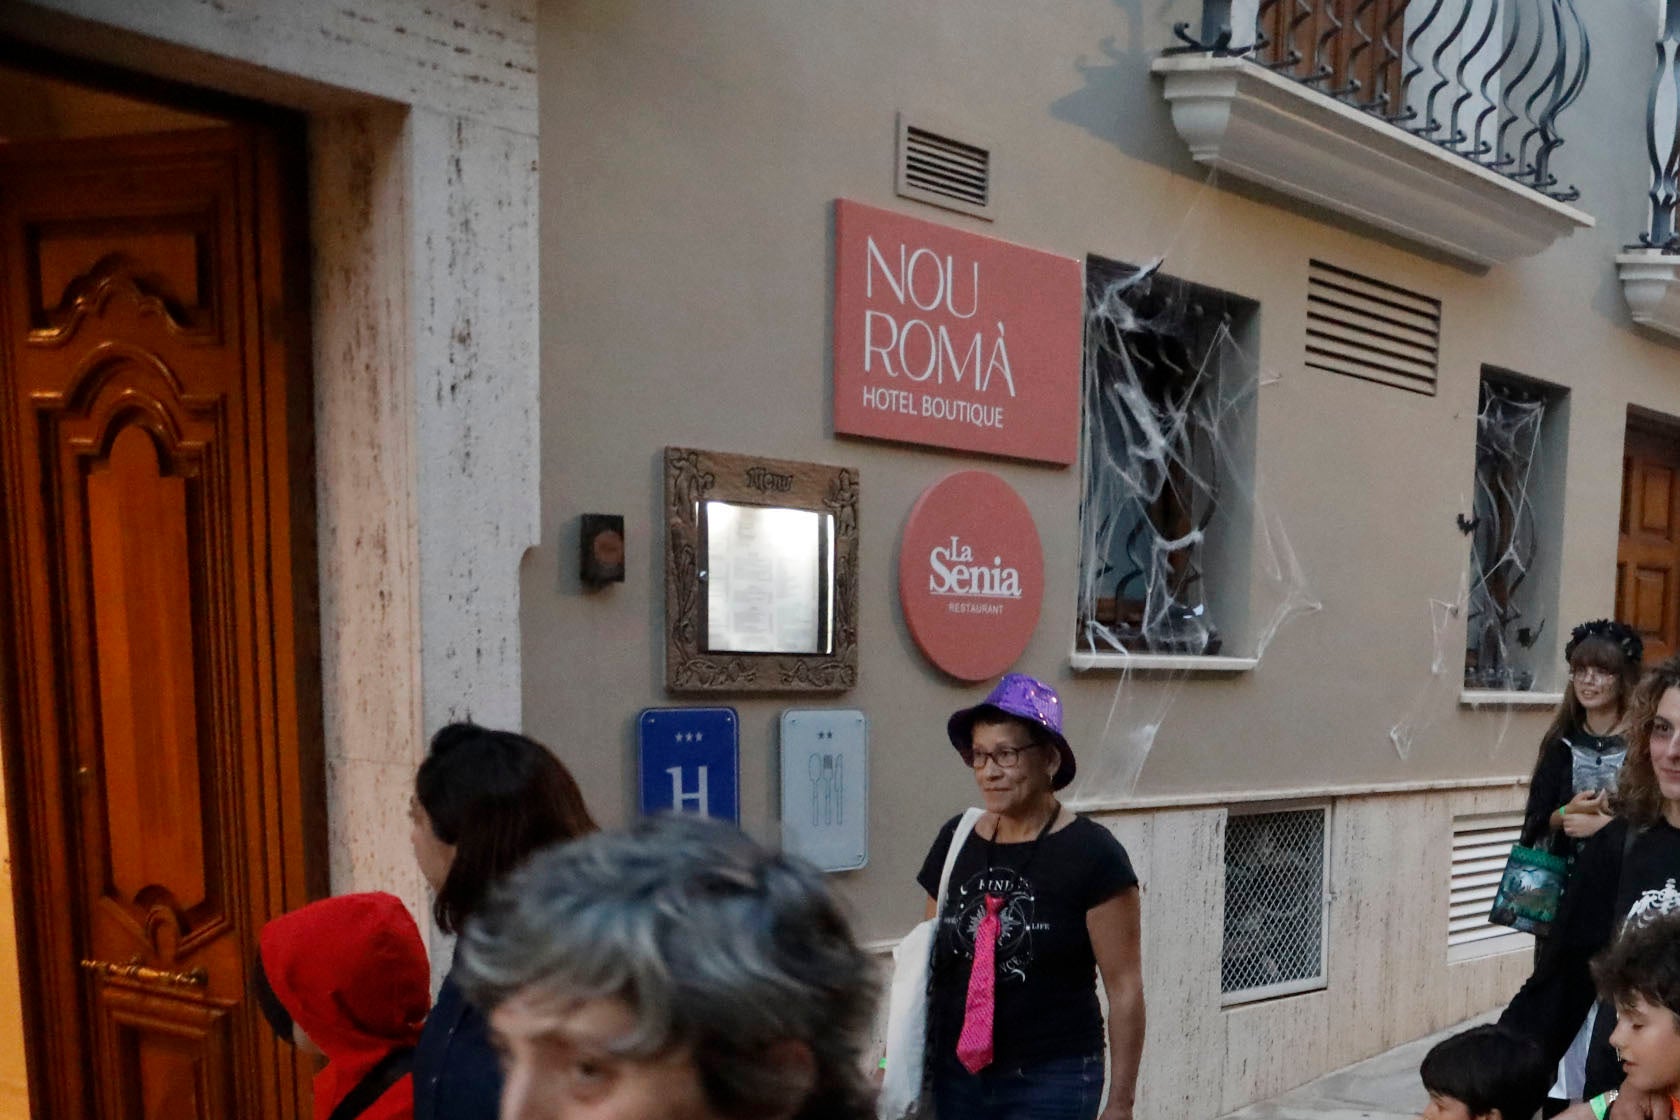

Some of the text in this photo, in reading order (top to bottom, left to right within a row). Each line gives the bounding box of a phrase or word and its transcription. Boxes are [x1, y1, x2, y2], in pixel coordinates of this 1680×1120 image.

[867, 236, 978, 318] NOU
[864, 310, 1015, 397] ROMÀ
[863, 386, 1004, 428] HOTEL BOUTIQUE
[929, 546, 1022, 597] Senia
[950, 536, 973, 562] La
[949, 602, 1004, 615] RESTAURANT
